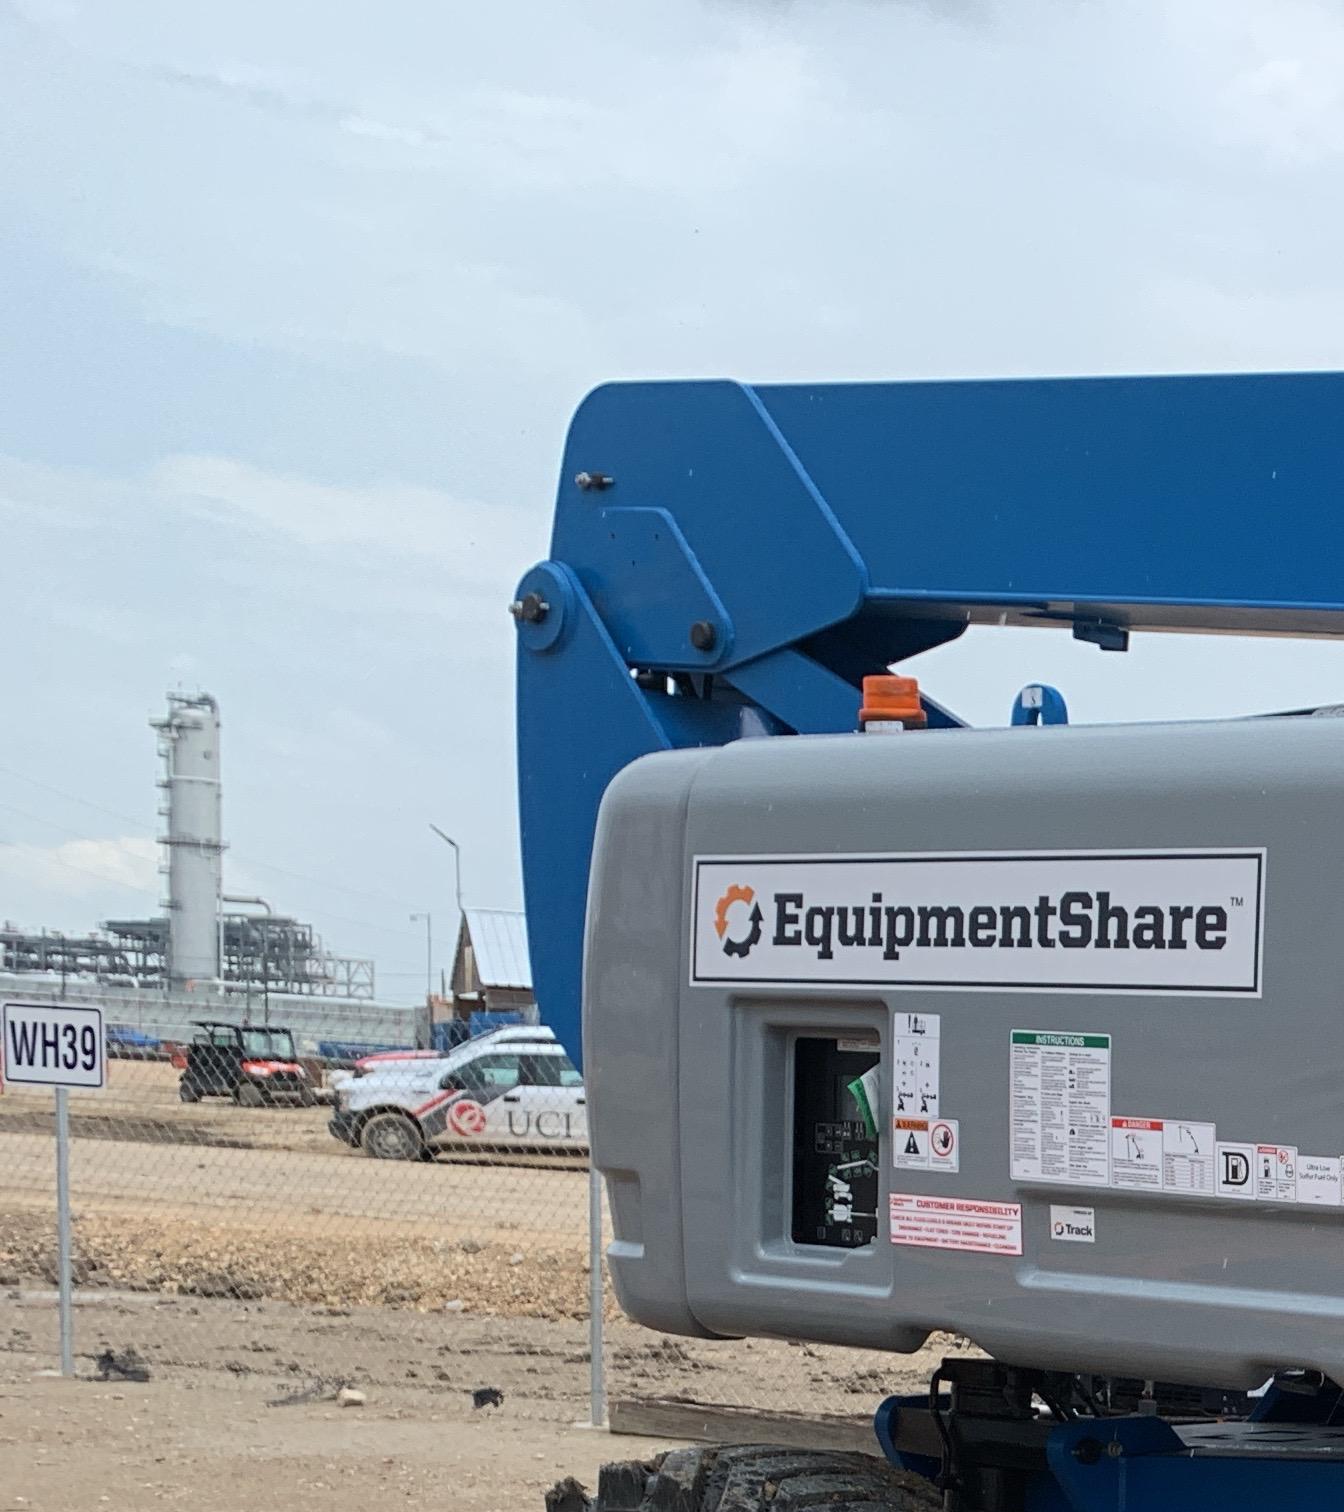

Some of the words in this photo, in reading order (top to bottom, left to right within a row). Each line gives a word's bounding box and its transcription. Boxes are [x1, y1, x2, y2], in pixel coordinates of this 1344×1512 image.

[10, 1020, 96, 1071] WH39
[1035, 1034, 1085, 1047] INSTRUCTIONS
[916, 1199, 955, 1211] CUSTOMER
[956, 1203, 1019, 1216] RESPONSIBILITY
[1065, 1223, 1093, 1236] Track
